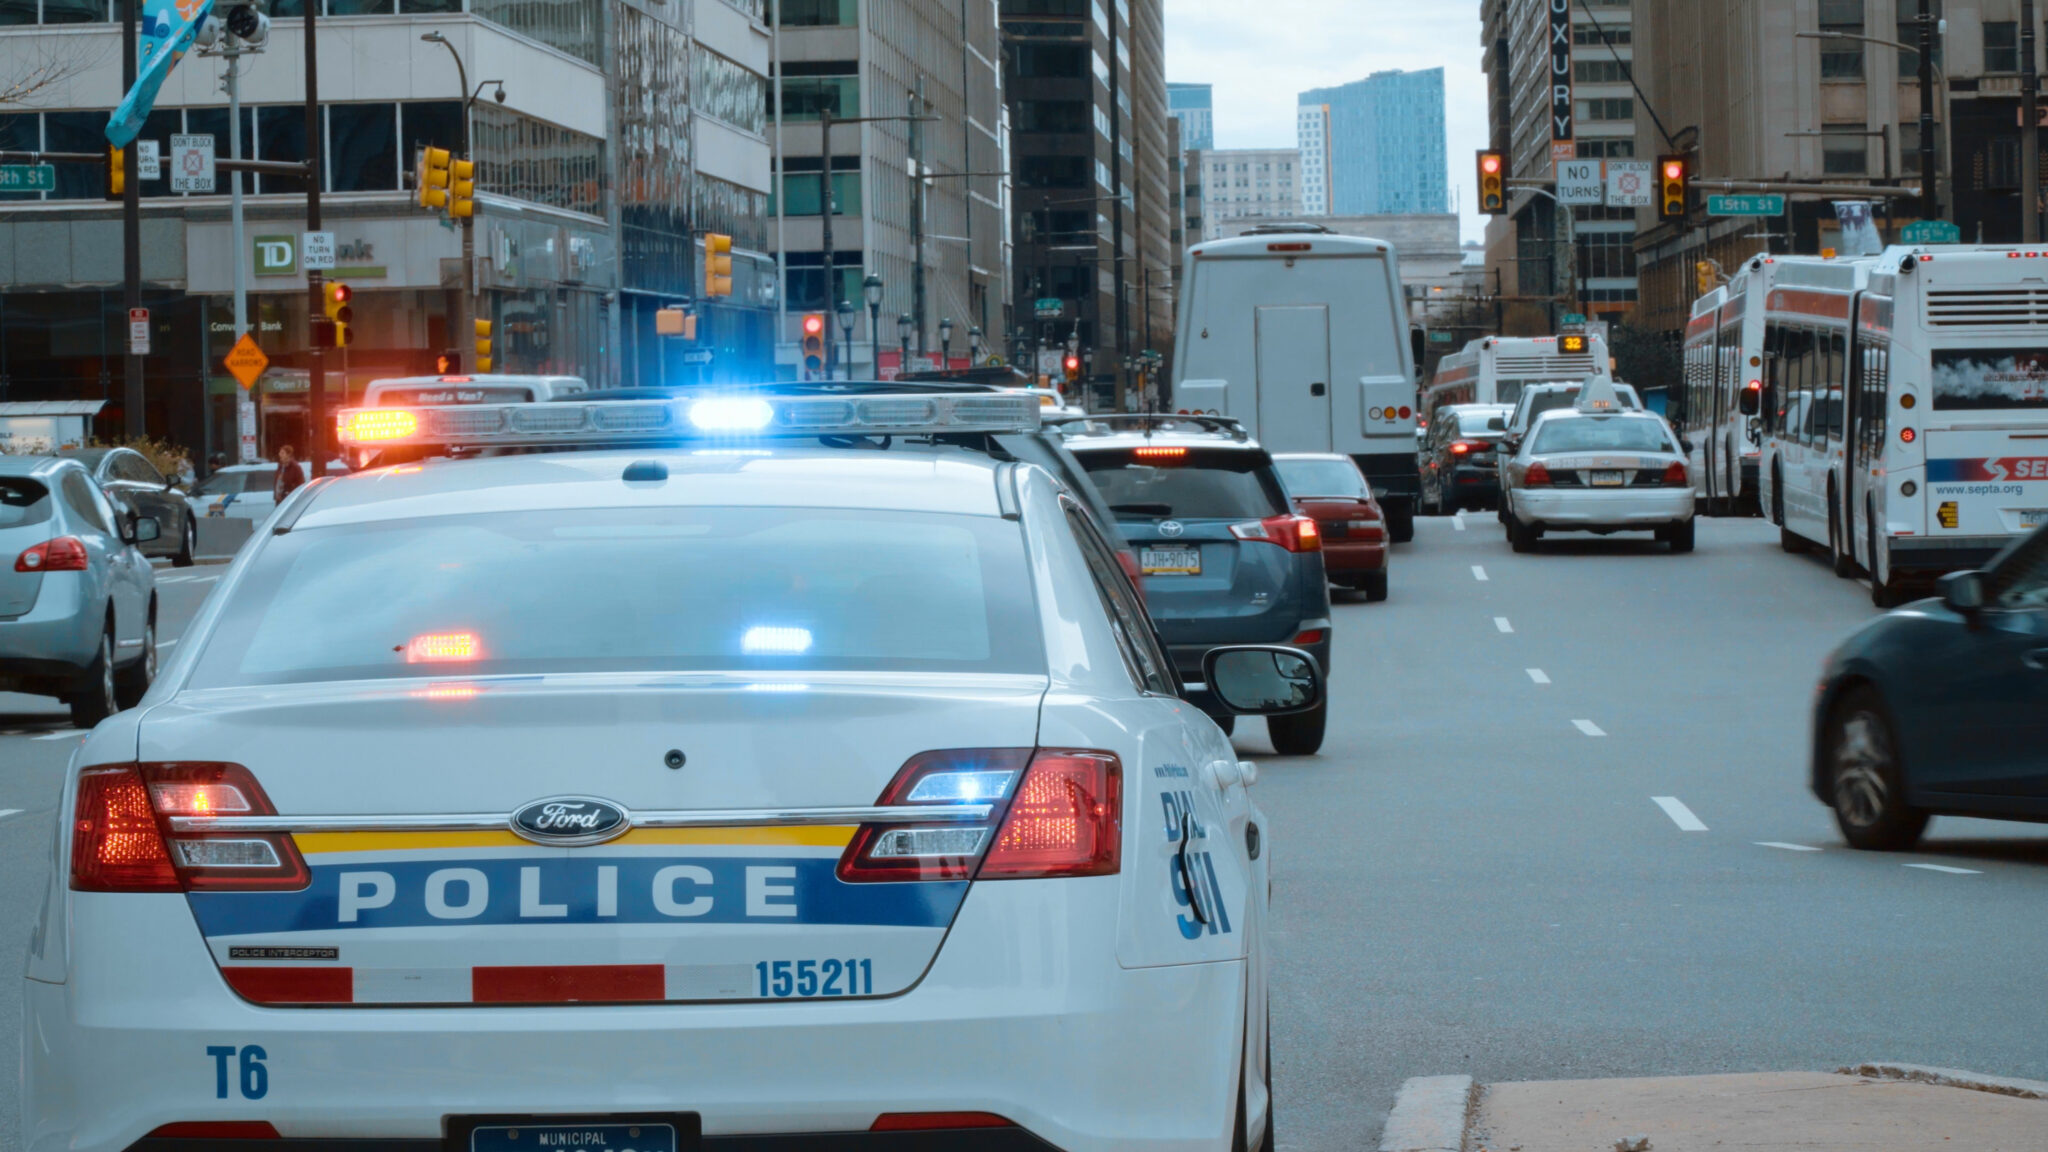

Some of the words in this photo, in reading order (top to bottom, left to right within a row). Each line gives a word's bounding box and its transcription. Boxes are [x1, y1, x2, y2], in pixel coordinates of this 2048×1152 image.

[192, 137, 211, 147] BLOCK
[1554, 144, 1573, 153] APT
[28, 170, 44, 184] St
[1567, 166, 1589, 179] NO
[175, 178, 190, 189] THE
[195, 177, 211, 189] BOX
[1560, 186, 1600, 198] TURNS
[1610, 195, 1625, 205] THE
[1630, 195, 1648, 205] BOX
[1718, 199, 1750, 211] 15th
[1757, 199, 1774, 211] St
[257, 241, 293, 267] TD
[336, 239, 374, 259] nk
[261, 321, 282, 331] Bank
[1566, 337, 1582, 349] 32
[273, 380, 295, 390] Open
[2015, 460, 2048, 477] SE
[1936, 484, 2023, 495] www.septa.org
[536, 803, 600, 829] Ford
[338, 865, 798, 922] POLICE
[231, 949, 265, 957] POLICE
[267, 949, 336, 958] INTERCEPTOR
[755, 959, 873, 997] 155211
[206, 1045, 269, 1100] T6
[539, 1132, 607, 1146] MUNICIPAL
